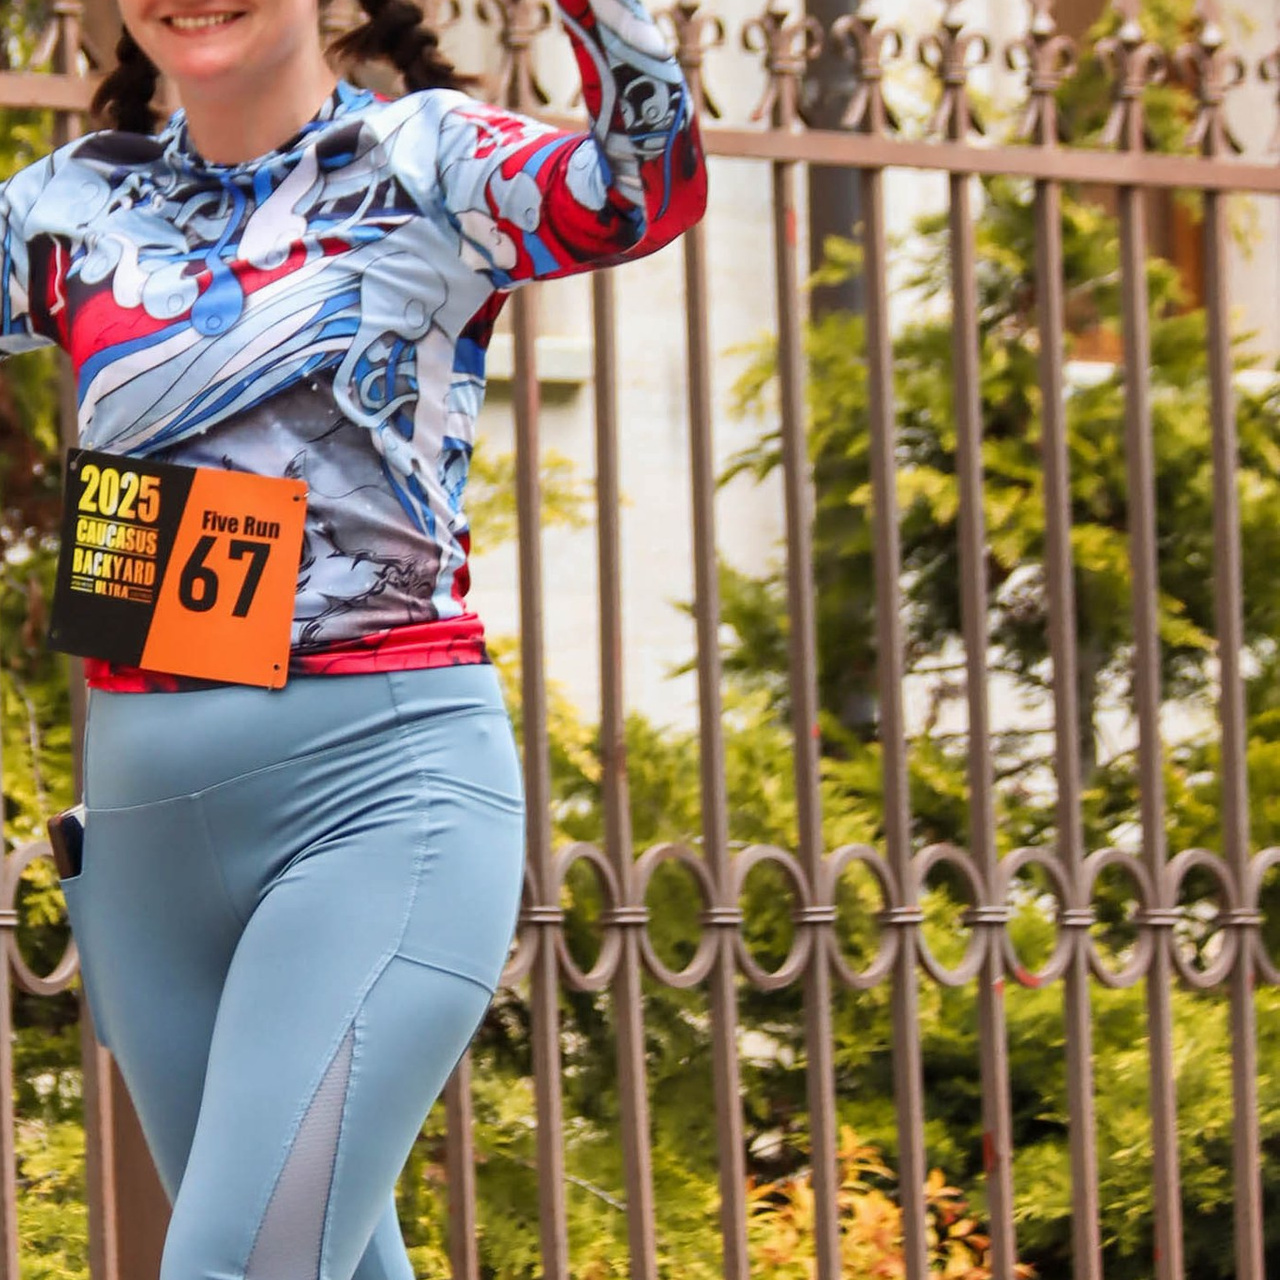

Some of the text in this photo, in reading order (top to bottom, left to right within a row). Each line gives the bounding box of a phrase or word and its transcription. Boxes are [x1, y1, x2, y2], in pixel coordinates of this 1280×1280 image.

[78, 464, 161, 523] 2025
[76, 518, 158, 555] CAUCASUS
[202, 510, 280, 539] Five Run
[72, 547, 156, 586] BACKYARD
[178, 535, 271, 618] 67
[94, 580, 129, 598] ULTRA
